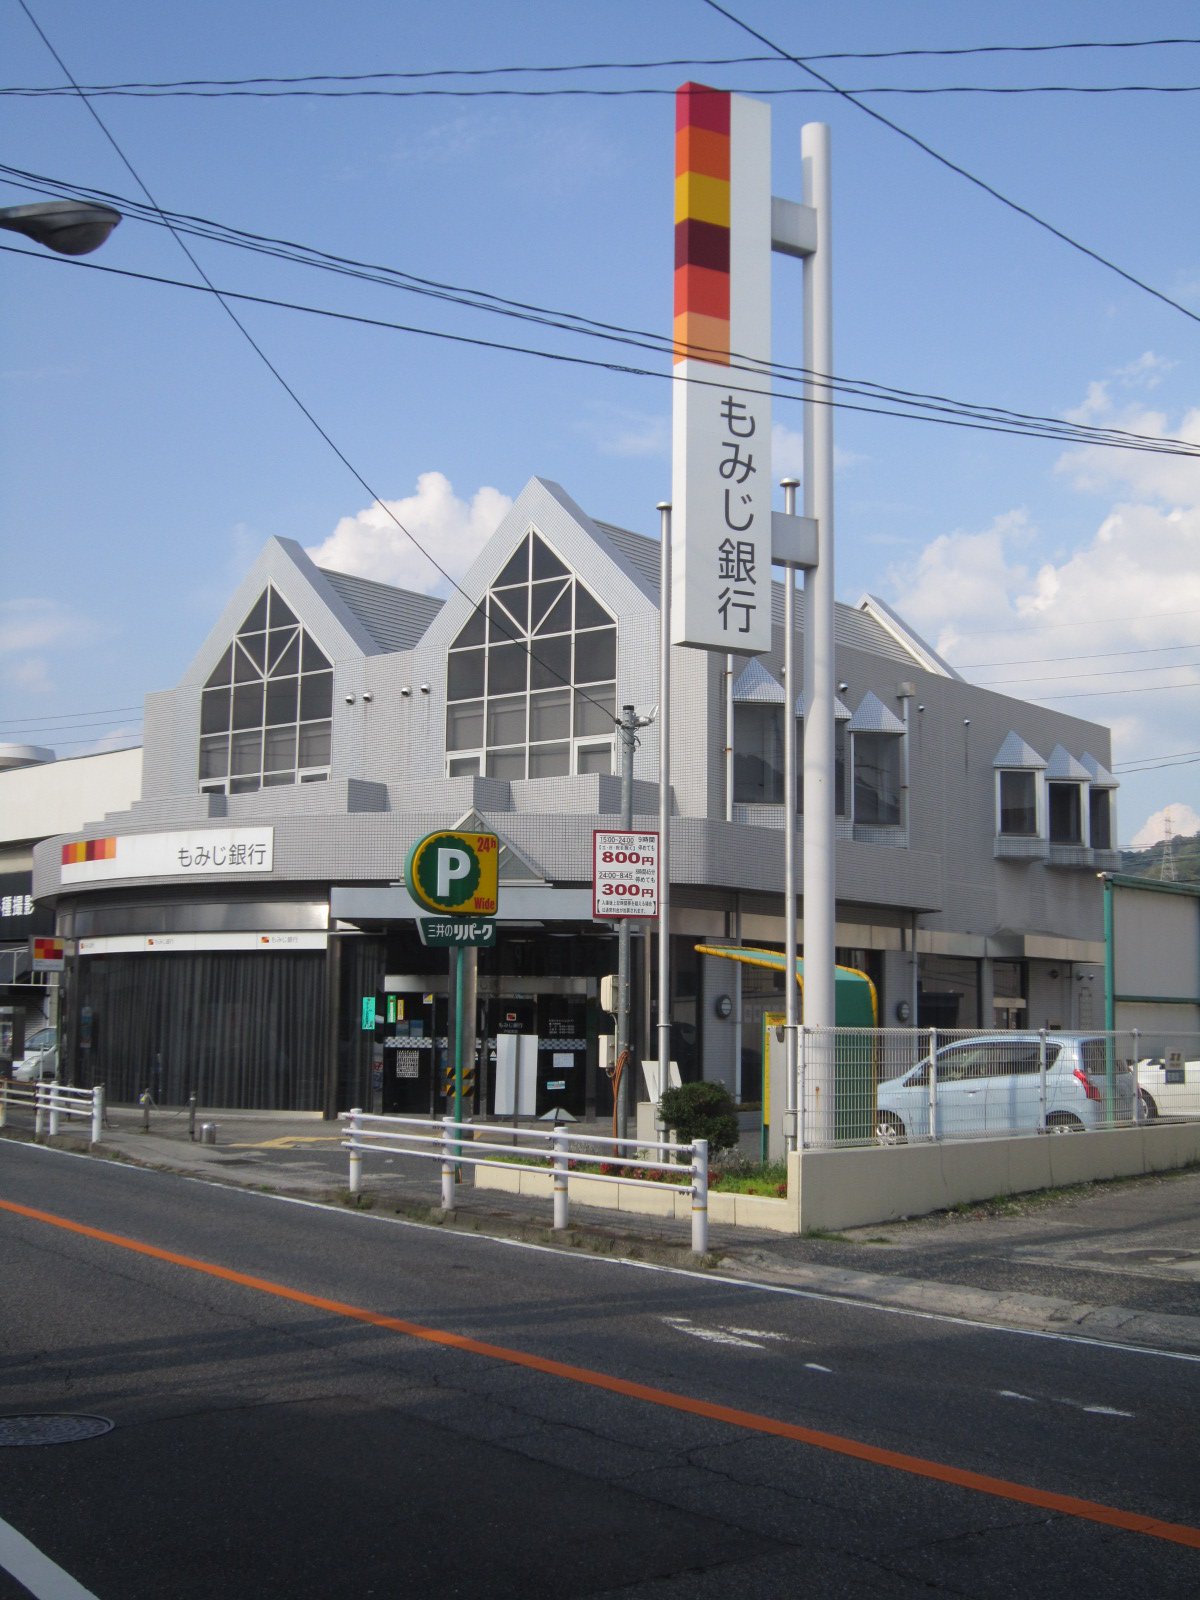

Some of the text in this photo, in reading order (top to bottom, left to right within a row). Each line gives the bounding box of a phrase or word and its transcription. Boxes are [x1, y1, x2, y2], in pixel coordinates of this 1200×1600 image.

[718, 395, 757, 633] もみじ銀行
[477, 837, 497, 853] 24h
[177, 843, 267, 868] もみじ銀行
[601, 851, 654, 866] 800円
[437, 847, 472, 898] P
[601, 883, 654, 898] 300円
[474, 897, 496, 910] Wide
[427, 922, 493, 941] 三井のリパーク
